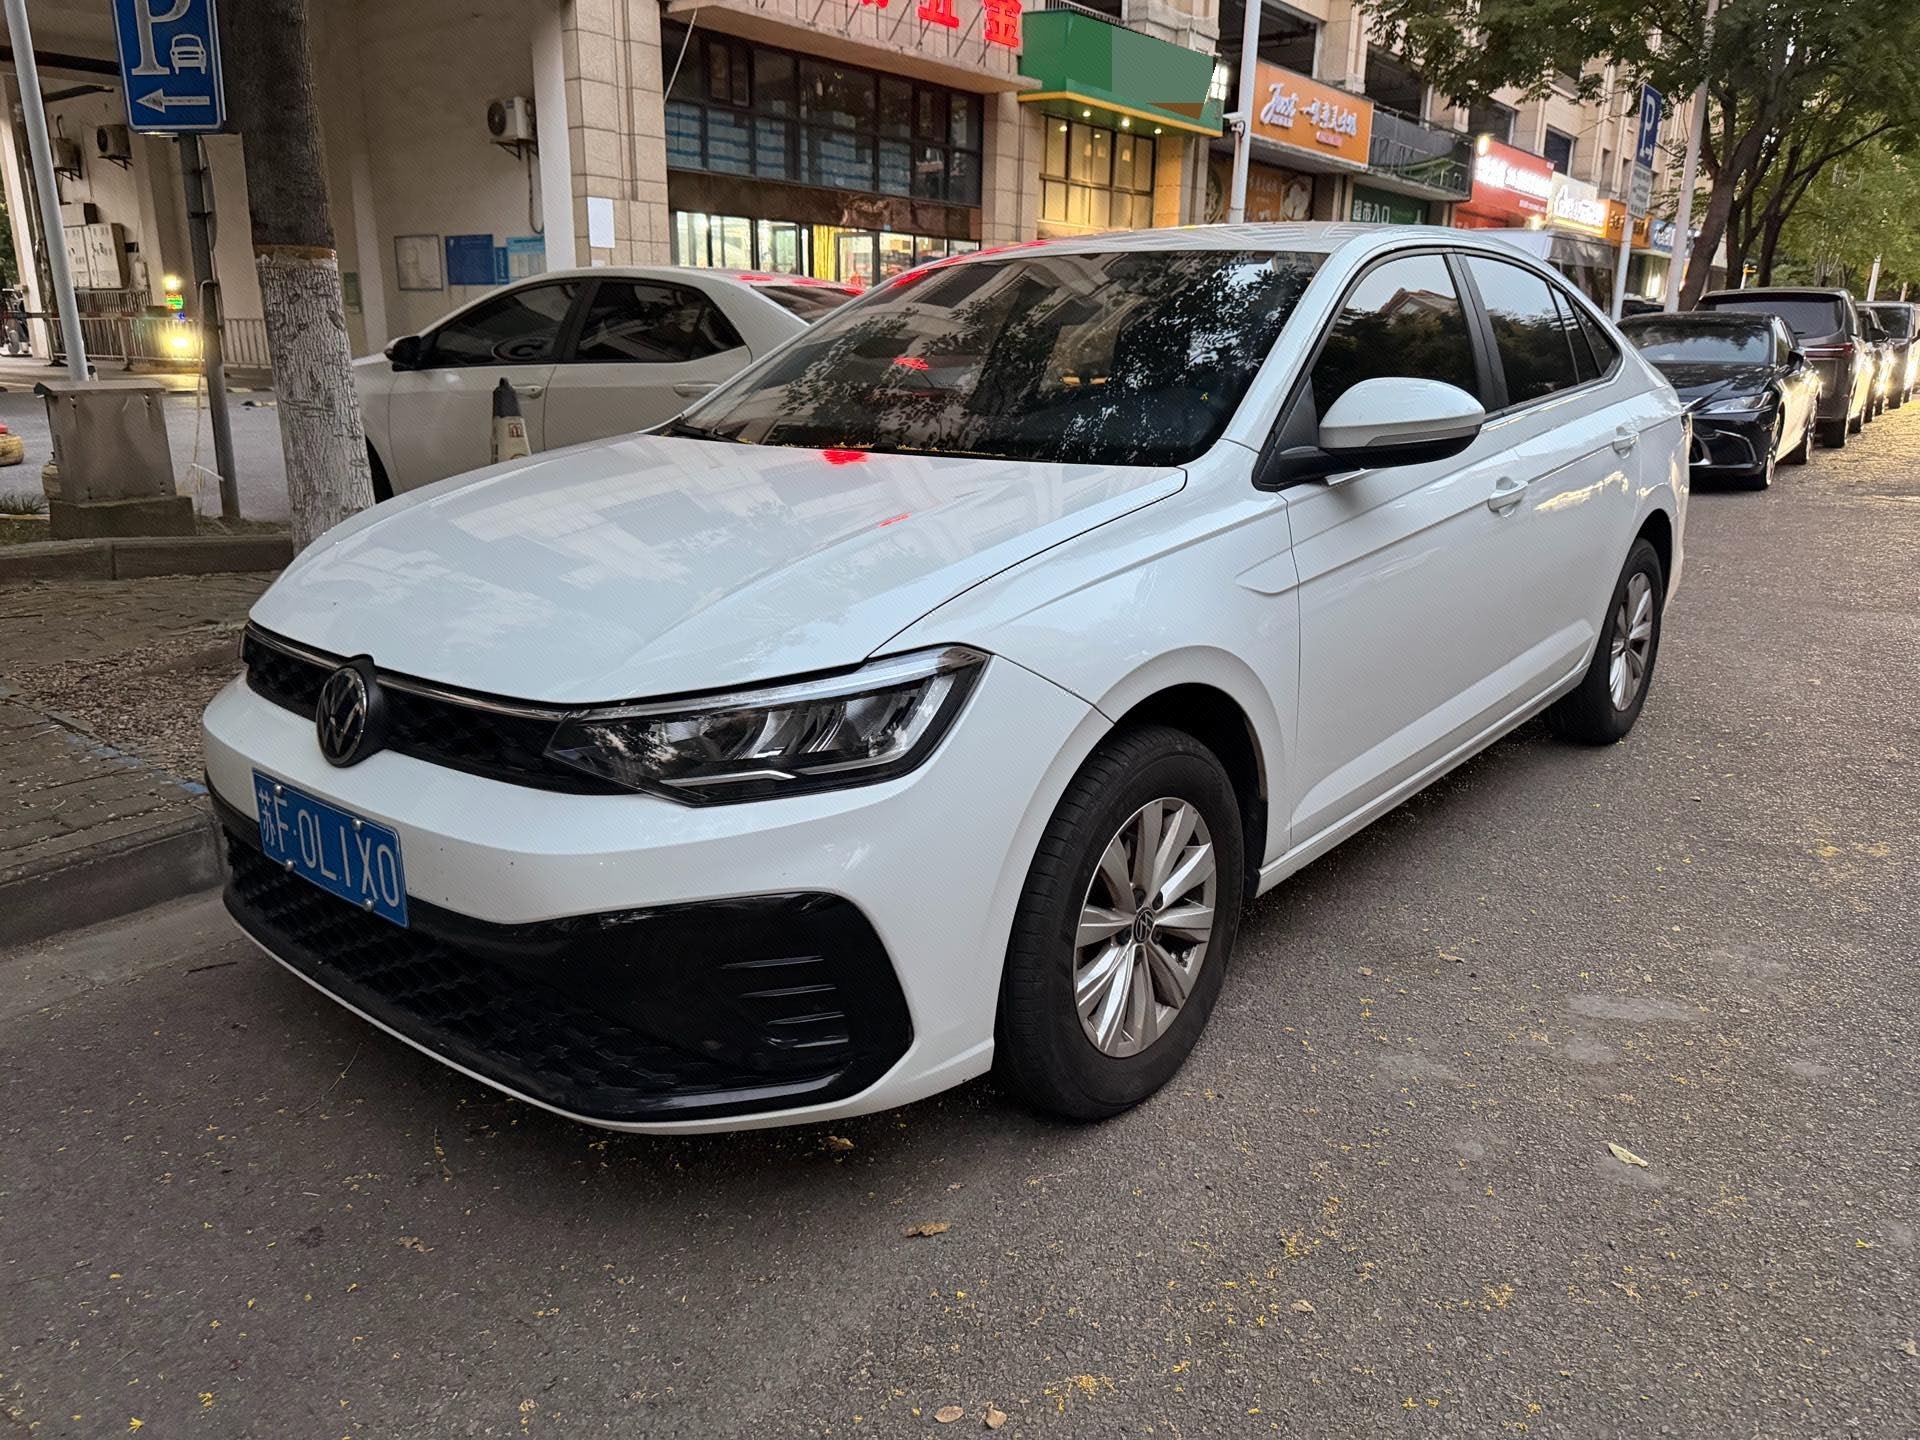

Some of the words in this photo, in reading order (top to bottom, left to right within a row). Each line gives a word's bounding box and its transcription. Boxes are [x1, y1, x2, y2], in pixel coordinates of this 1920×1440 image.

[132, 0, 191, 75] P
[1640, 94, 1656, 157] P
[1352, 200, 1391, 224] 超市入口
